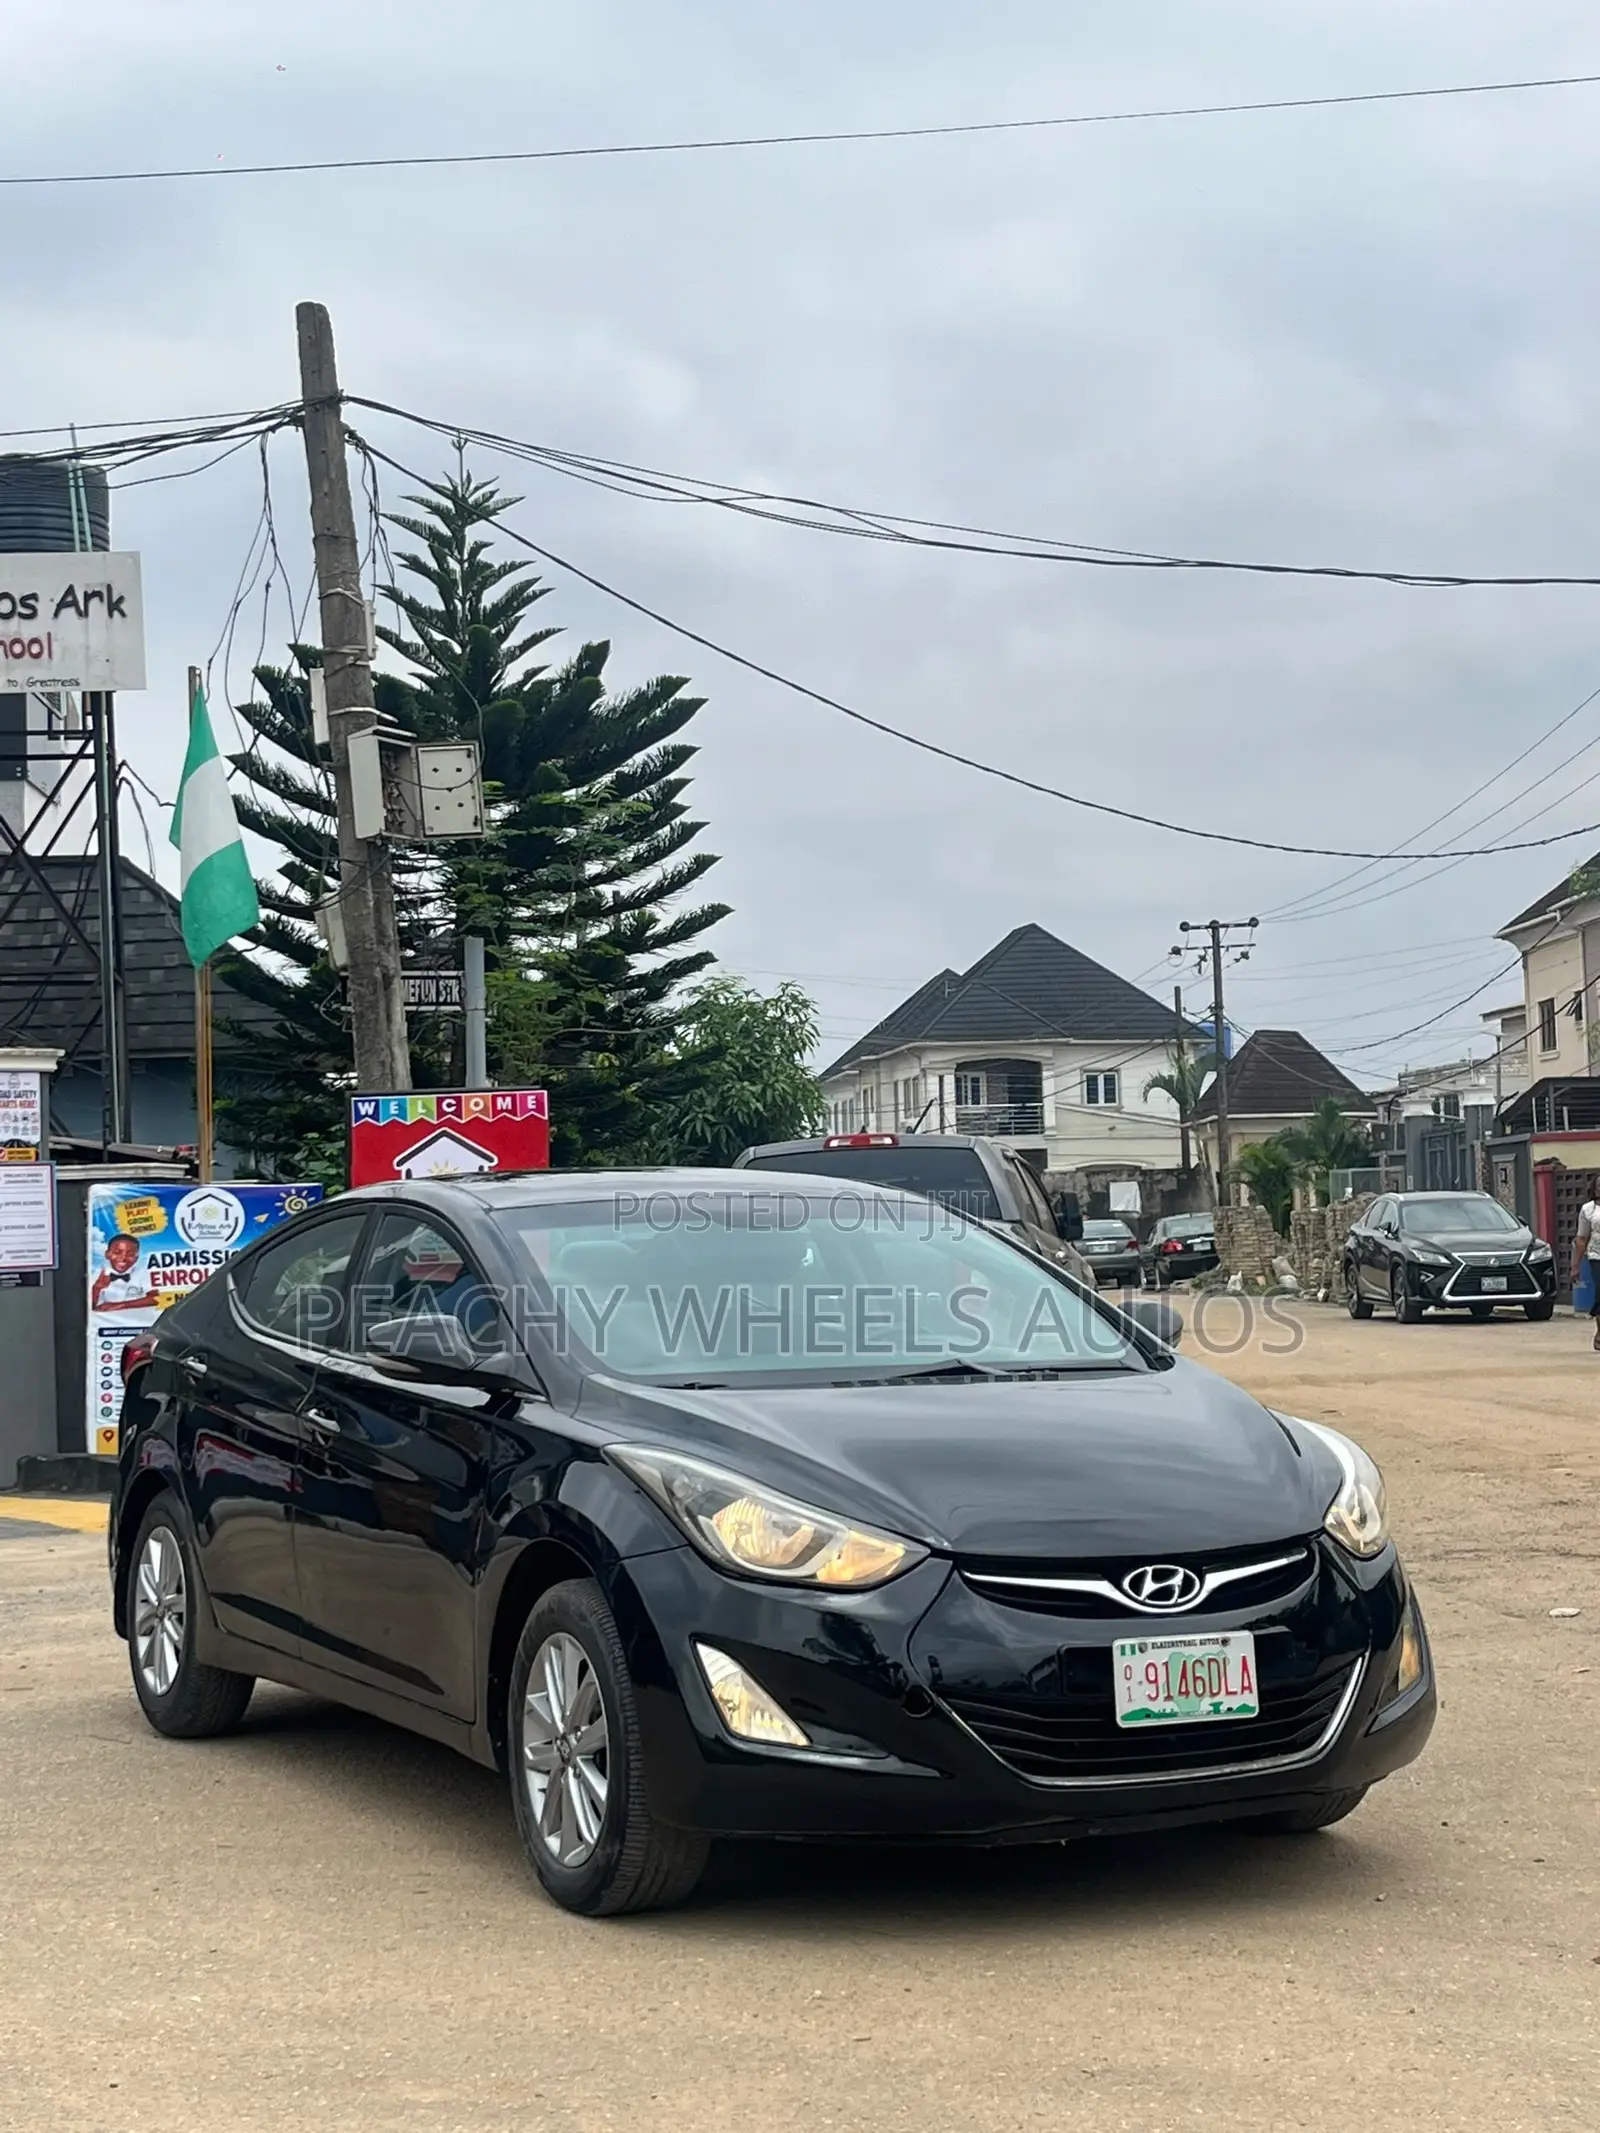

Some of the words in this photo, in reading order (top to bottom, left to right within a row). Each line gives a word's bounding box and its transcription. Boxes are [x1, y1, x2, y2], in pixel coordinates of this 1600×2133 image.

[53, 583, 127, 619] Ark
[7, 677, 19, 687] to
[13, 1089, 37, 1099] SAFETY
[358, 1095, 537, 1116] WELCOME
[1144, 1655, 1254, 1702] 9146DLA
